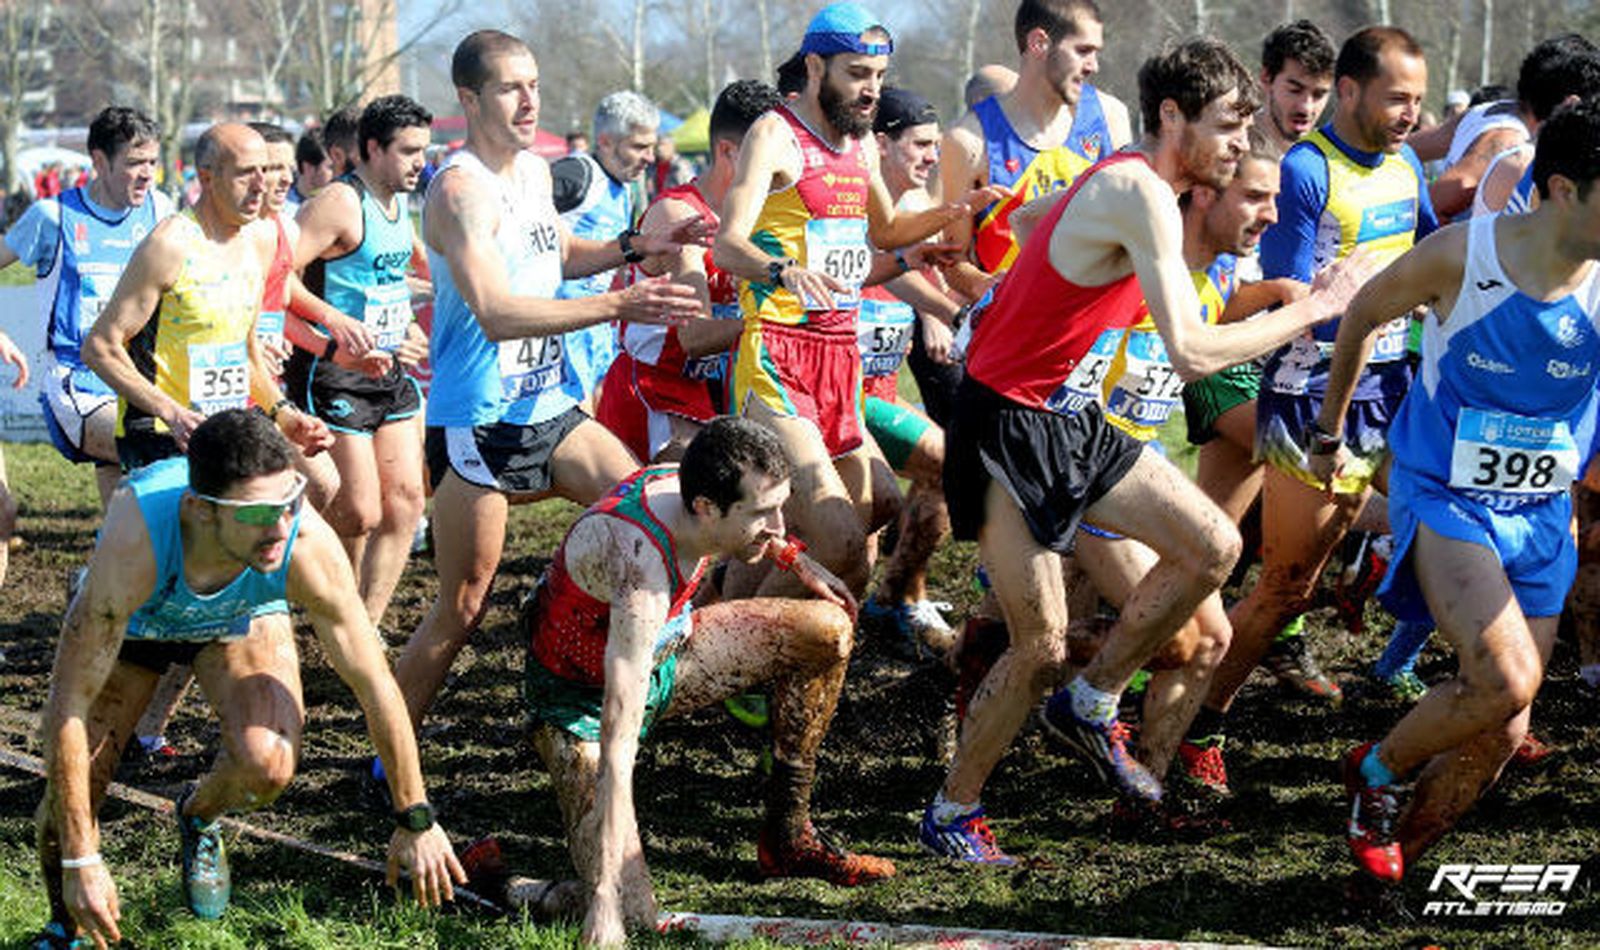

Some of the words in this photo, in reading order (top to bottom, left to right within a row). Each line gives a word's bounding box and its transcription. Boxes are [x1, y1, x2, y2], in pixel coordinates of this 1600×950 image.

[517, 337, 561, 367] 475
[203, 367, 245, 397] 353
[1473, 447, 1557, 488] 398
